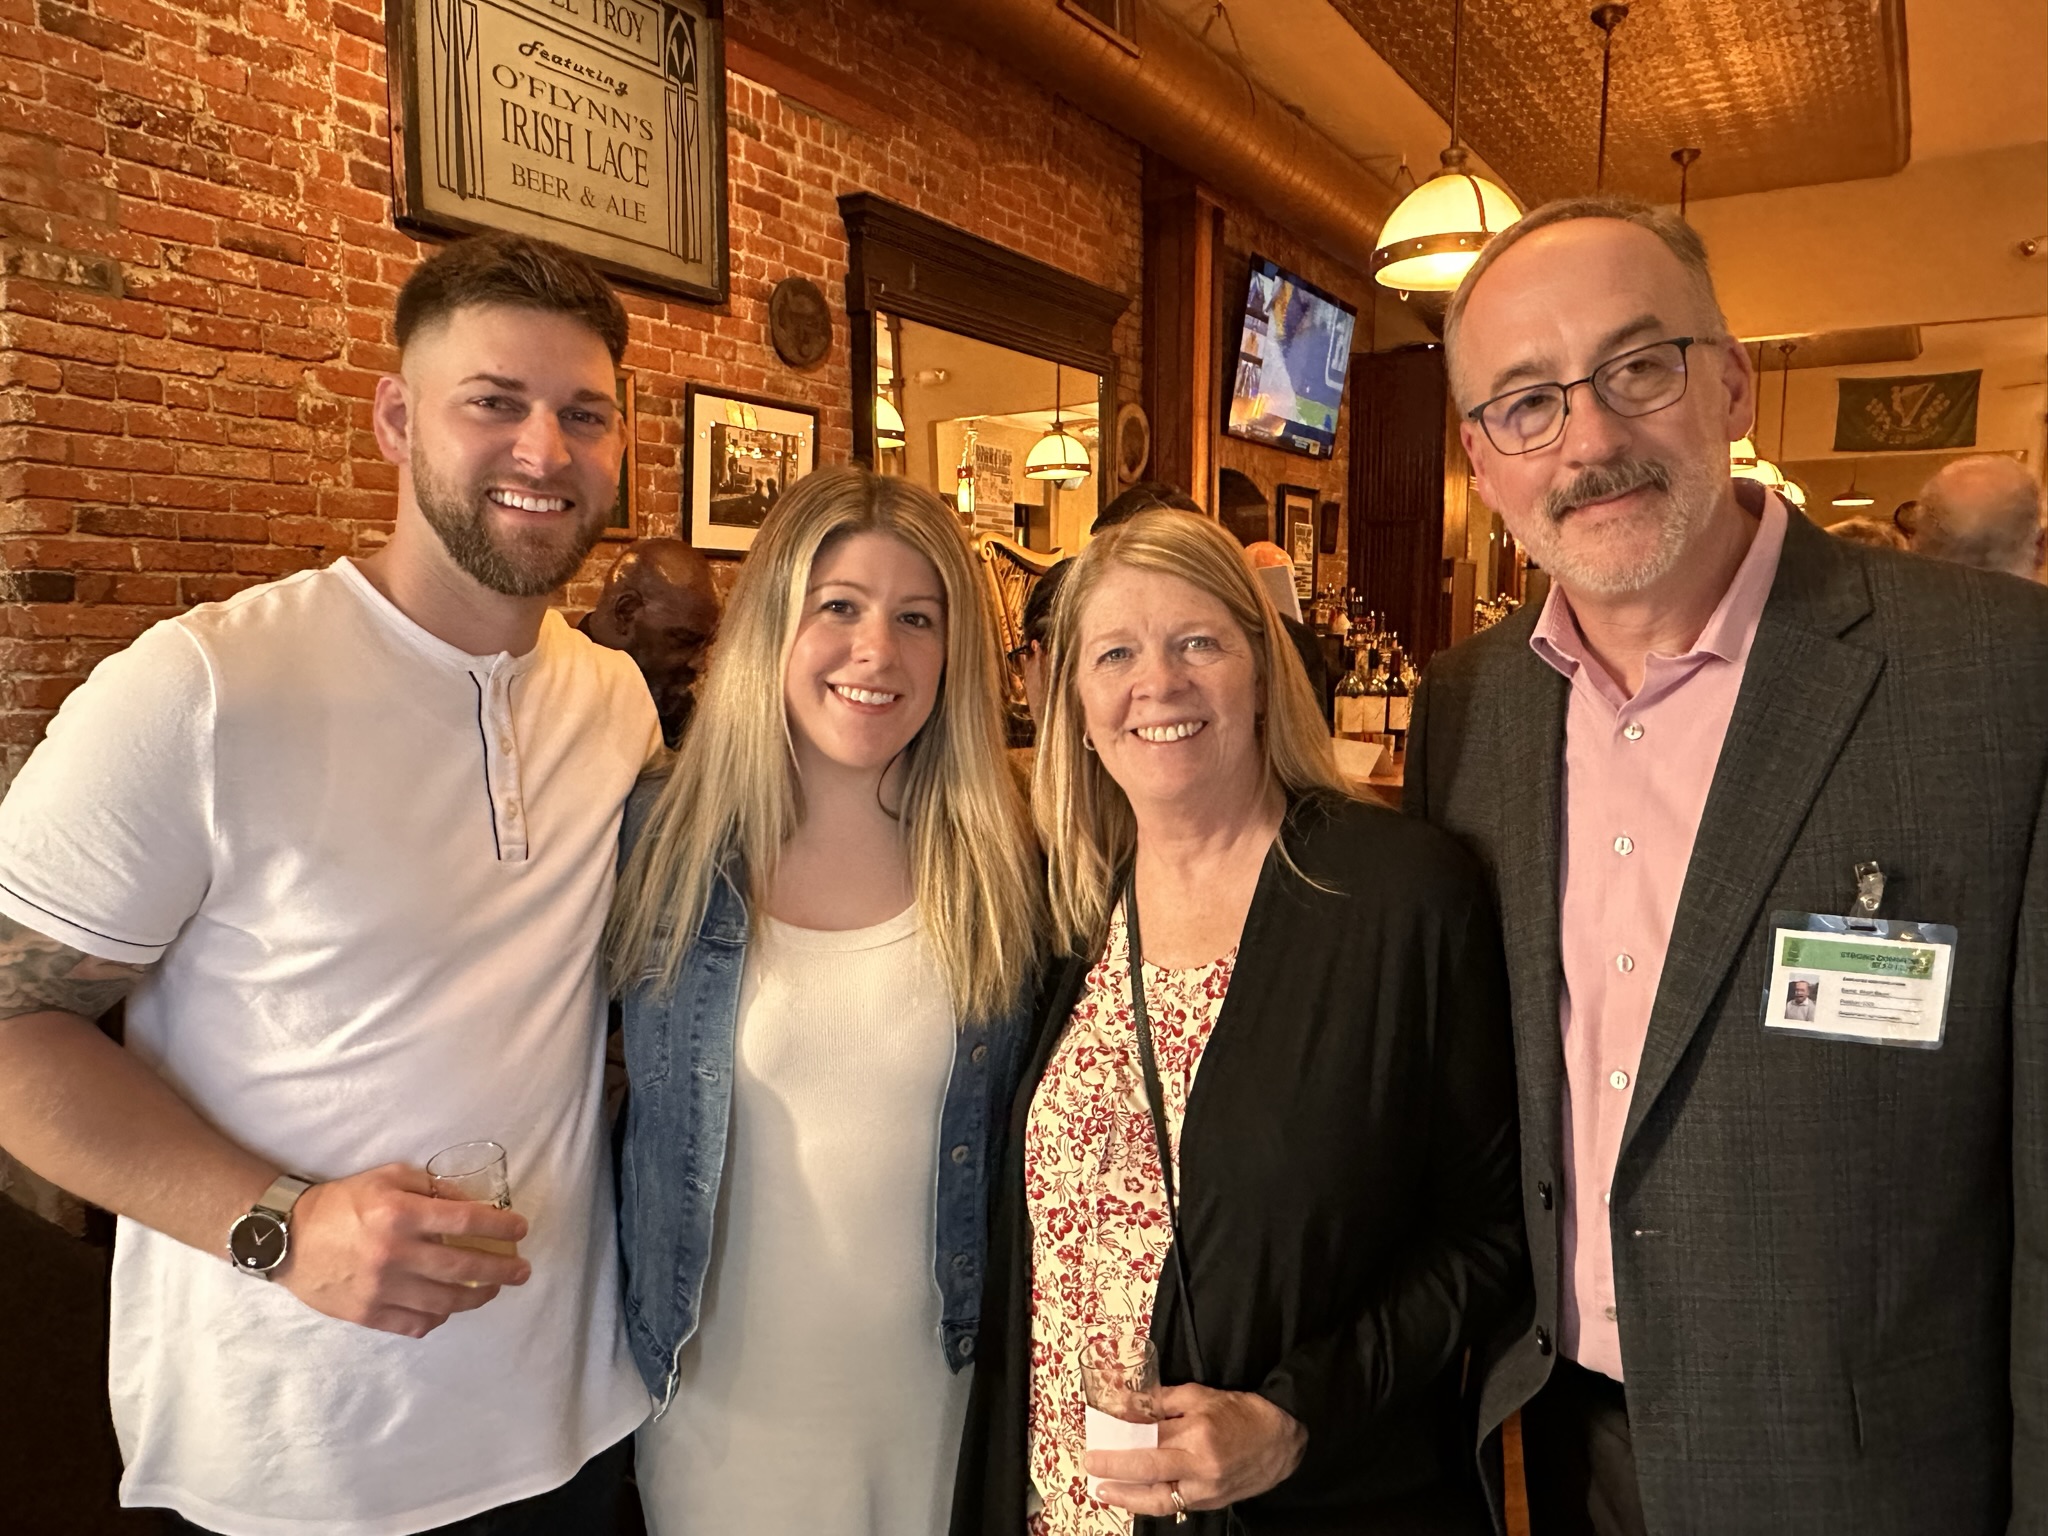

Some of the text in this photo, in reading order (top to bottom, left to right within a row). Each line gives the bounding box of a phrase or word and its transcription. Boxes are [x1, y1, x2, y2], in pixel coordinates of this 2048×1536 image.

[592, 0, 645, 43] TROY
[518, 40, 629, 97] Featuring
[492, 63, 654, 141] O'FLYNN'S
[500, 97, 650, 188] IRISH LACE
[511, 162, 648, 224] BEER & ALE
